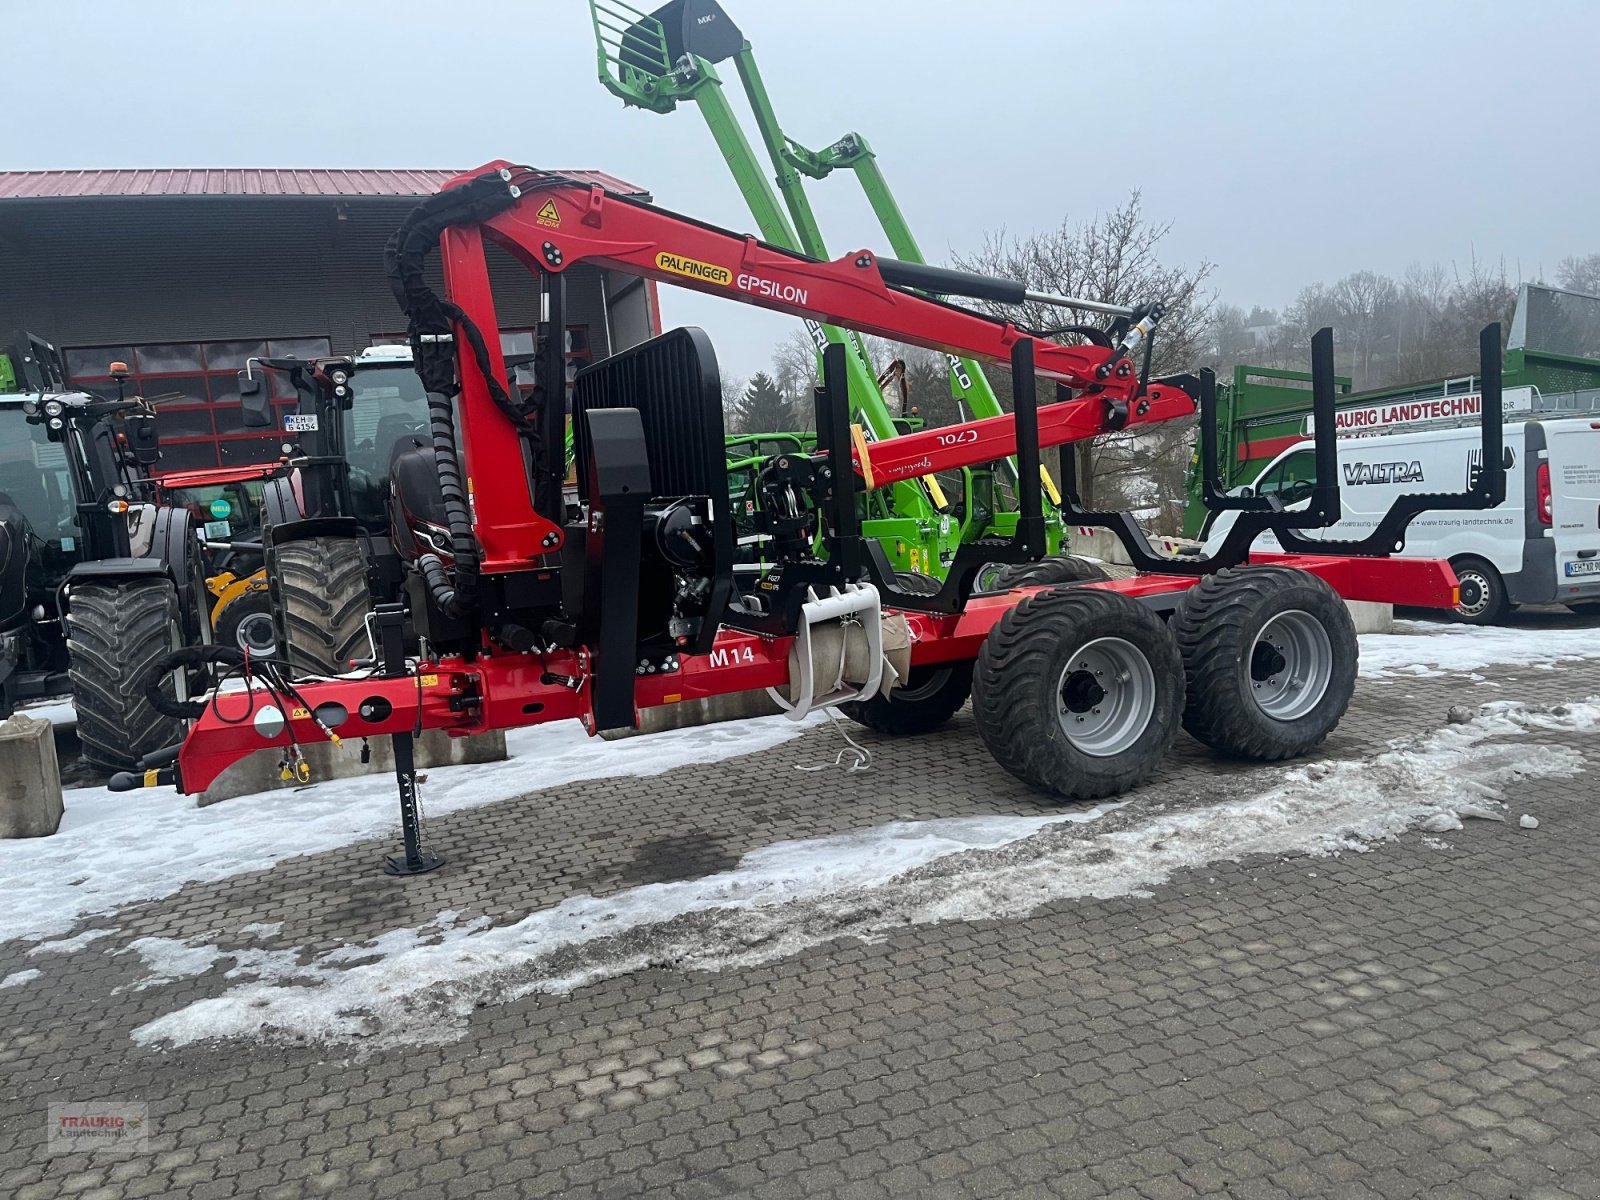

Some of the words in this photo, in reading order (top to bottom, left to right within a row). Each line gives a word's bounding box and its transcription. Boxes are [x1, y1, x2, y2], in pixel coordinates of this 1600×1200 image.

[536, 218, 560, 229] 20M
[660, 254, 728, 283] PALFINGER
[736, 273, 808, 305] EPSILON
[946, 353, 972, 389] RLO
[290, 416, 306, 424] KEH
[1335, 409, 1377, 429] AURIG
[1381, 396, 1481, 423] LANDTECHNI
[296, 423, 315, 431] 4154
[937, 429, 978, 446] C70L
[1343, 461, 1424, 486] VALTRA
